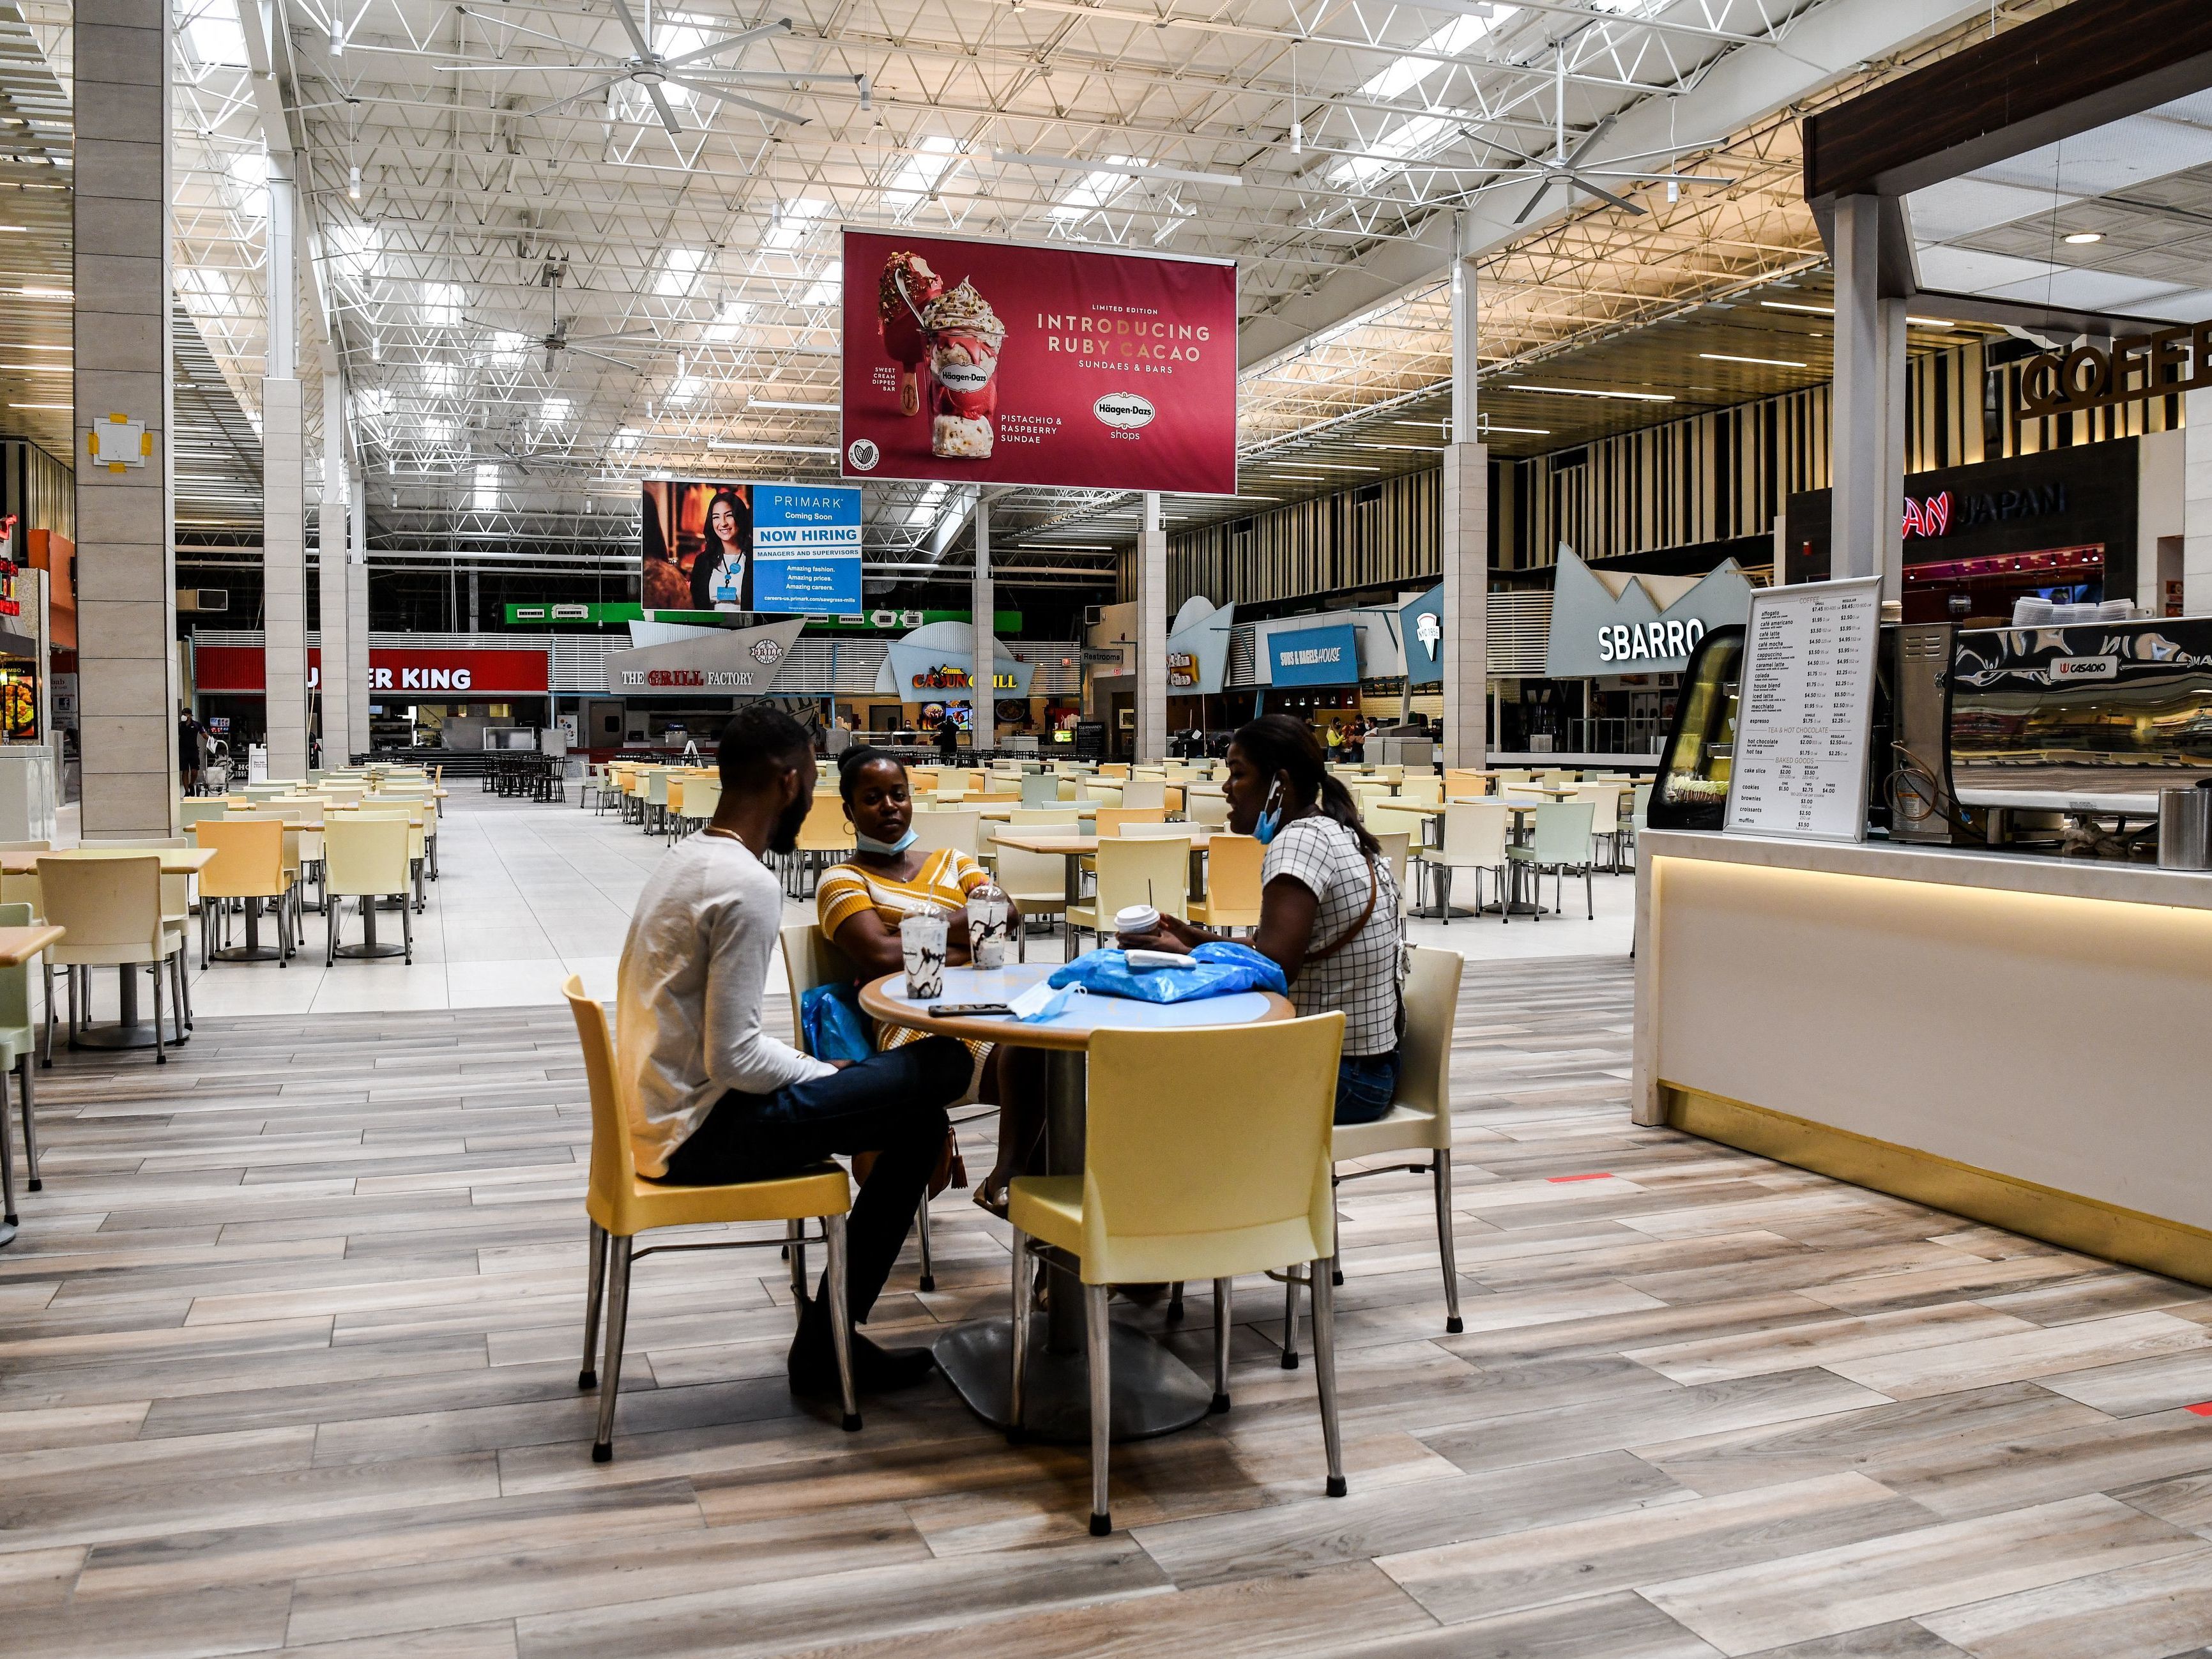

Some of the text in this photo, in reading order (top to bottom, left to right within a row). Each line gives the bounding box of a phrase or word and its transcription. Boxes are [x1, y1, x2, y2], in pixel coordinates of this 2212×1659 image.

[1038, 313, 1210, 341] INTRODUCING
[1048, 336, 1200, 362] RUBY CACAO
[1079, 360, 1129, 371] SUNDAES
[1146, 365, 1172, 374] BARS
[1001, 415, 1053, 424] PISTACHIO
[1001, 425, 1057, 434] RASPBERRY
[1111, 430, 1140, 441] shops
[1001, 435, 1040, 443] SUNDAE
[775, 496, 841, 508] PRIMARK
[1956, 482, 2066, 526] JAPAN
[785, 512, 812, 521] Coming
[760, 529, 857, 542] NOW HIRING
[1419, 628, 1438, 638] NYC 1956
[1598, 618, 1704, 661] SBARRO
[1319, 647, 1341, 663] HOUSE
[2071, 663, 2106, 673] CASADIO
[403, 668, 471, 689] KING
[622, 670, 754, 686] THE GRILL FACTORY
[912, 674, 967, 689] CAJUN
